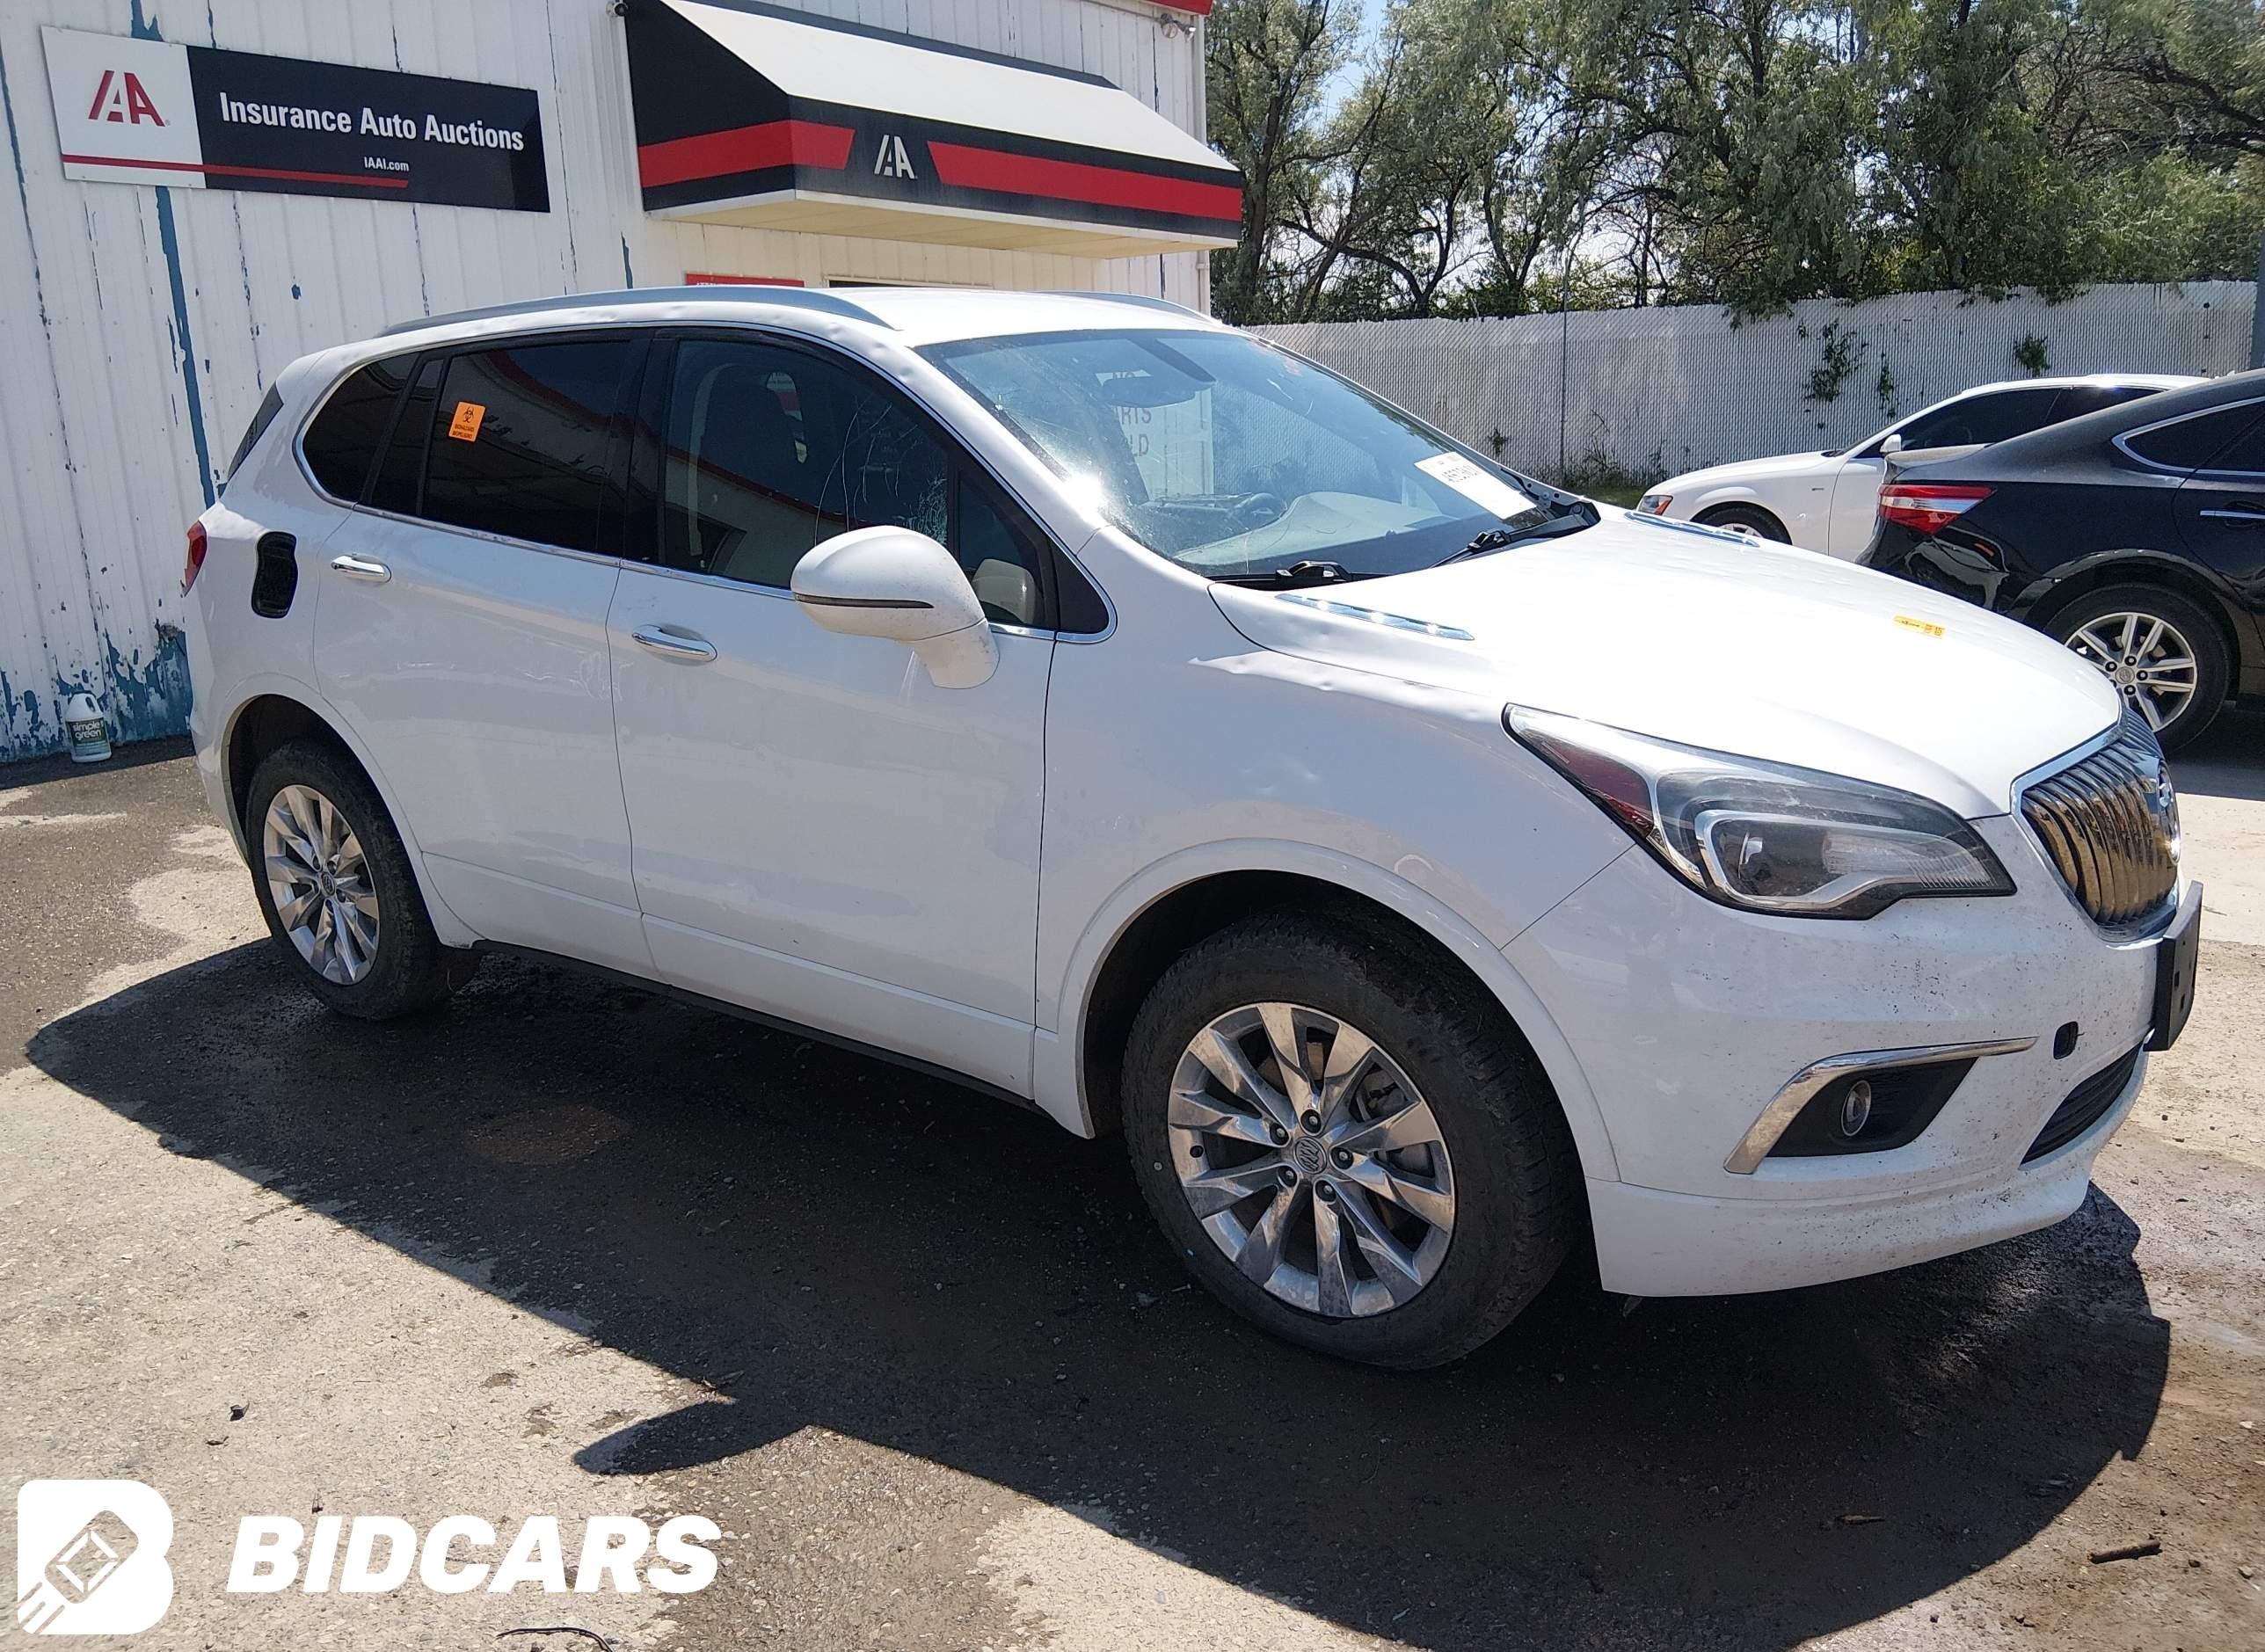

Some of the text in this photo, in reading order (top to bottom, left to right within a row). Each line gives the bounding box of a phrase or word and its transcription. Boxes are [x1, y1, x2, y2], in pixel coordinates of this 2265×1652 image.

[219, 91, 525, 151] Insurance Auto Auctions
[363, 156, 410, 172] IAAI.com
[72, 721, 100, 731] simple
[75, 730, 102, 740] green
